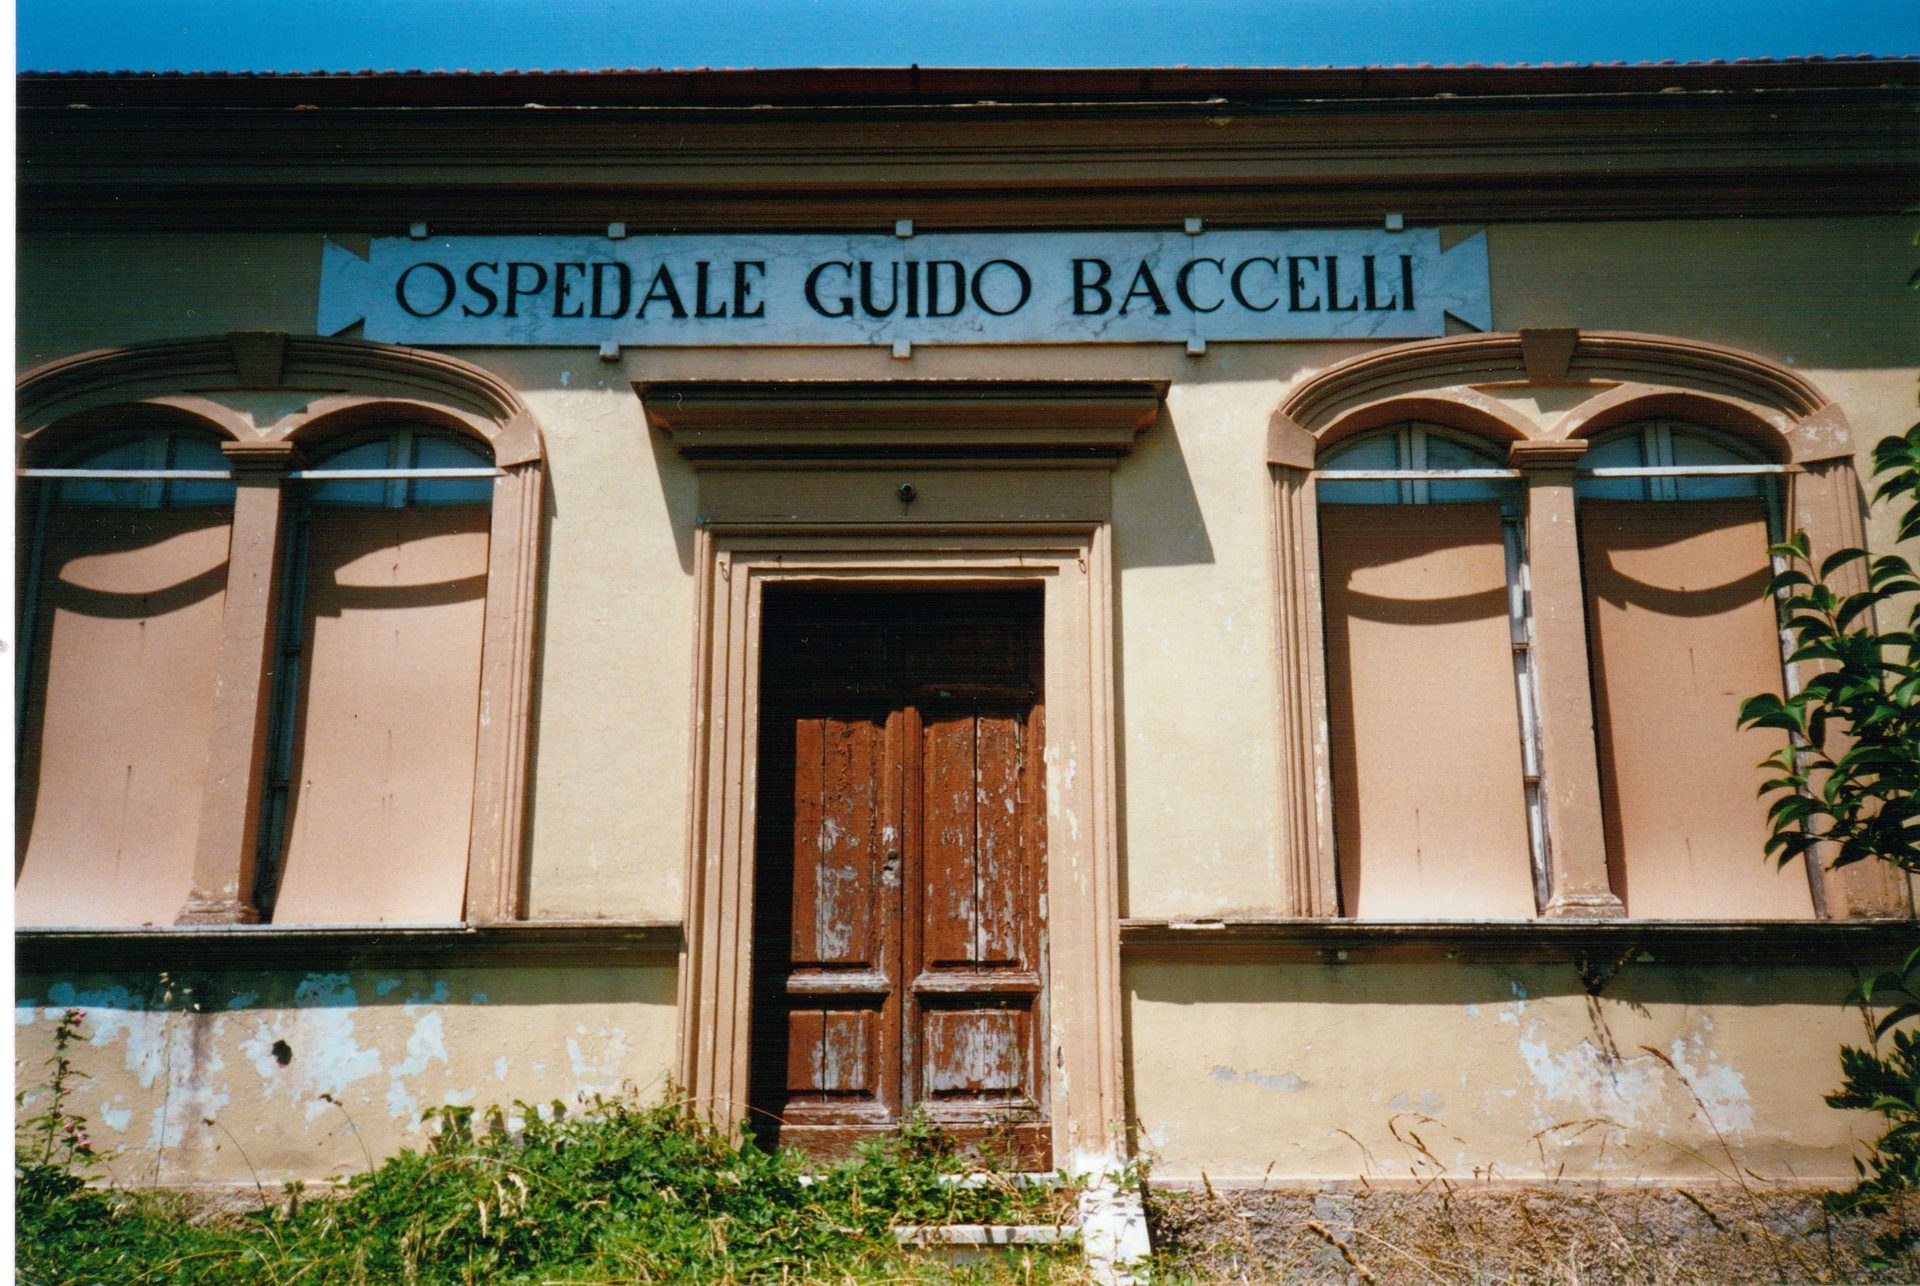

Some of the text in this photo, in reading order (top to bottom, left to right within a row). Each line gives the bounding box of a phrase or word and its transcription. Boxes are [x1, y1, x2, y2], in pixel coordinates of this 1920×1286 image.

[395, 253, 1418, 320] OSPEDALE GUIDO BACCELLI
